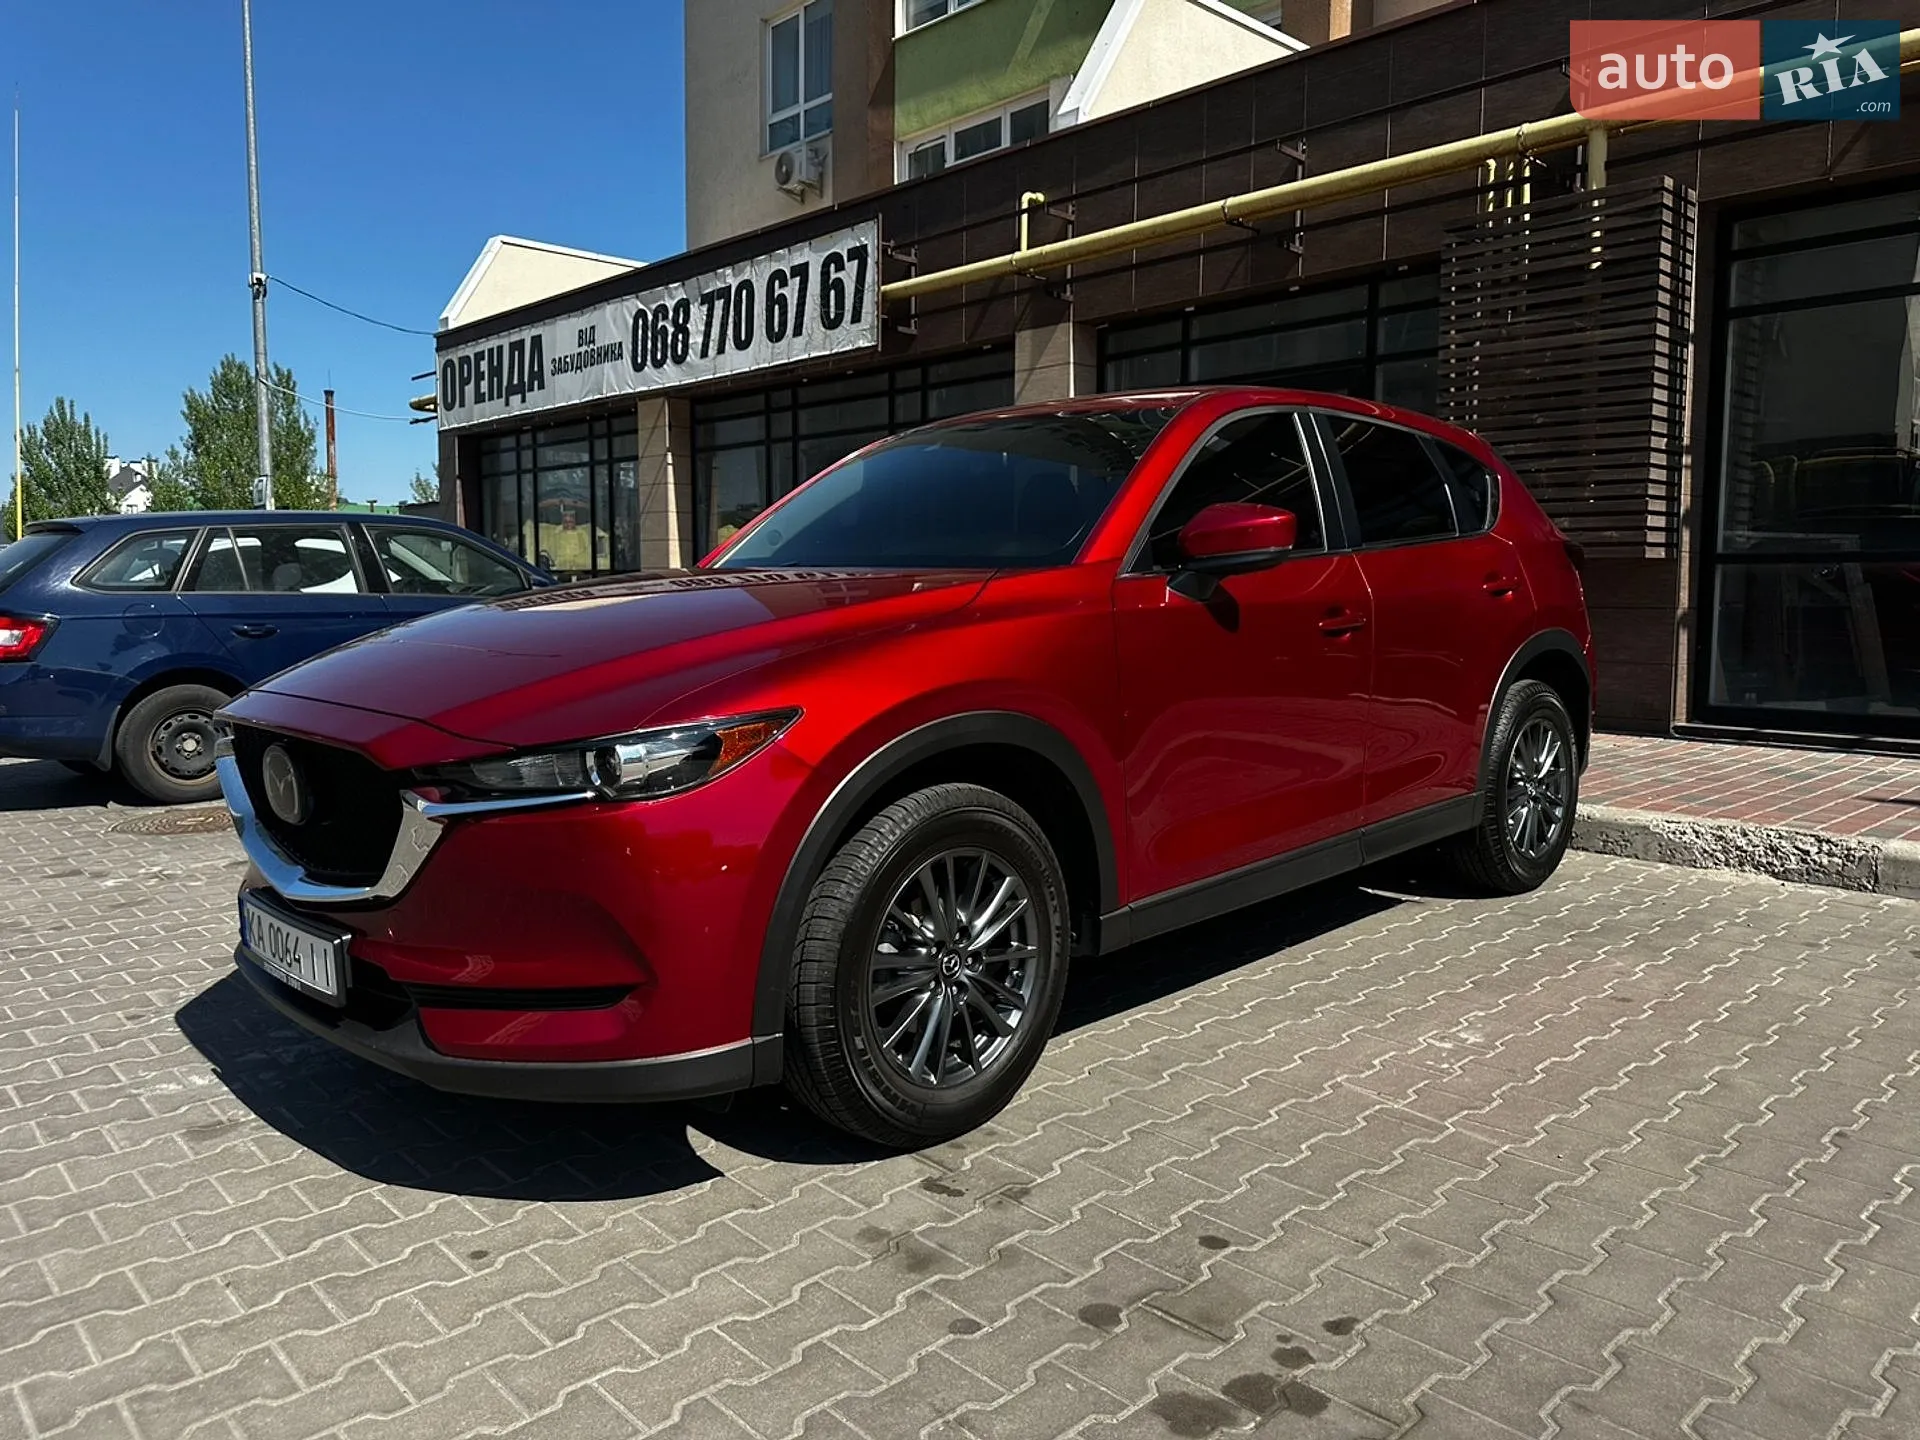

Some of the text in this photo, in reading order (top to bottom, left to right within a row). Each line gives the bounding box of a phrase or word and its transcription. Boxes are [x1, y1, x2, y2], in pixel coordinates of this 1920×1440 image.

[631, 244, 868, 374] 068 770 67 67
[550, 341, 623, 376] ЗАБУДОВНИКА
[577, 326, 596, 348] ВІД
[441, 334, 544, 412] ОРЕНДА
[268, 922, 303, 974] 0064
